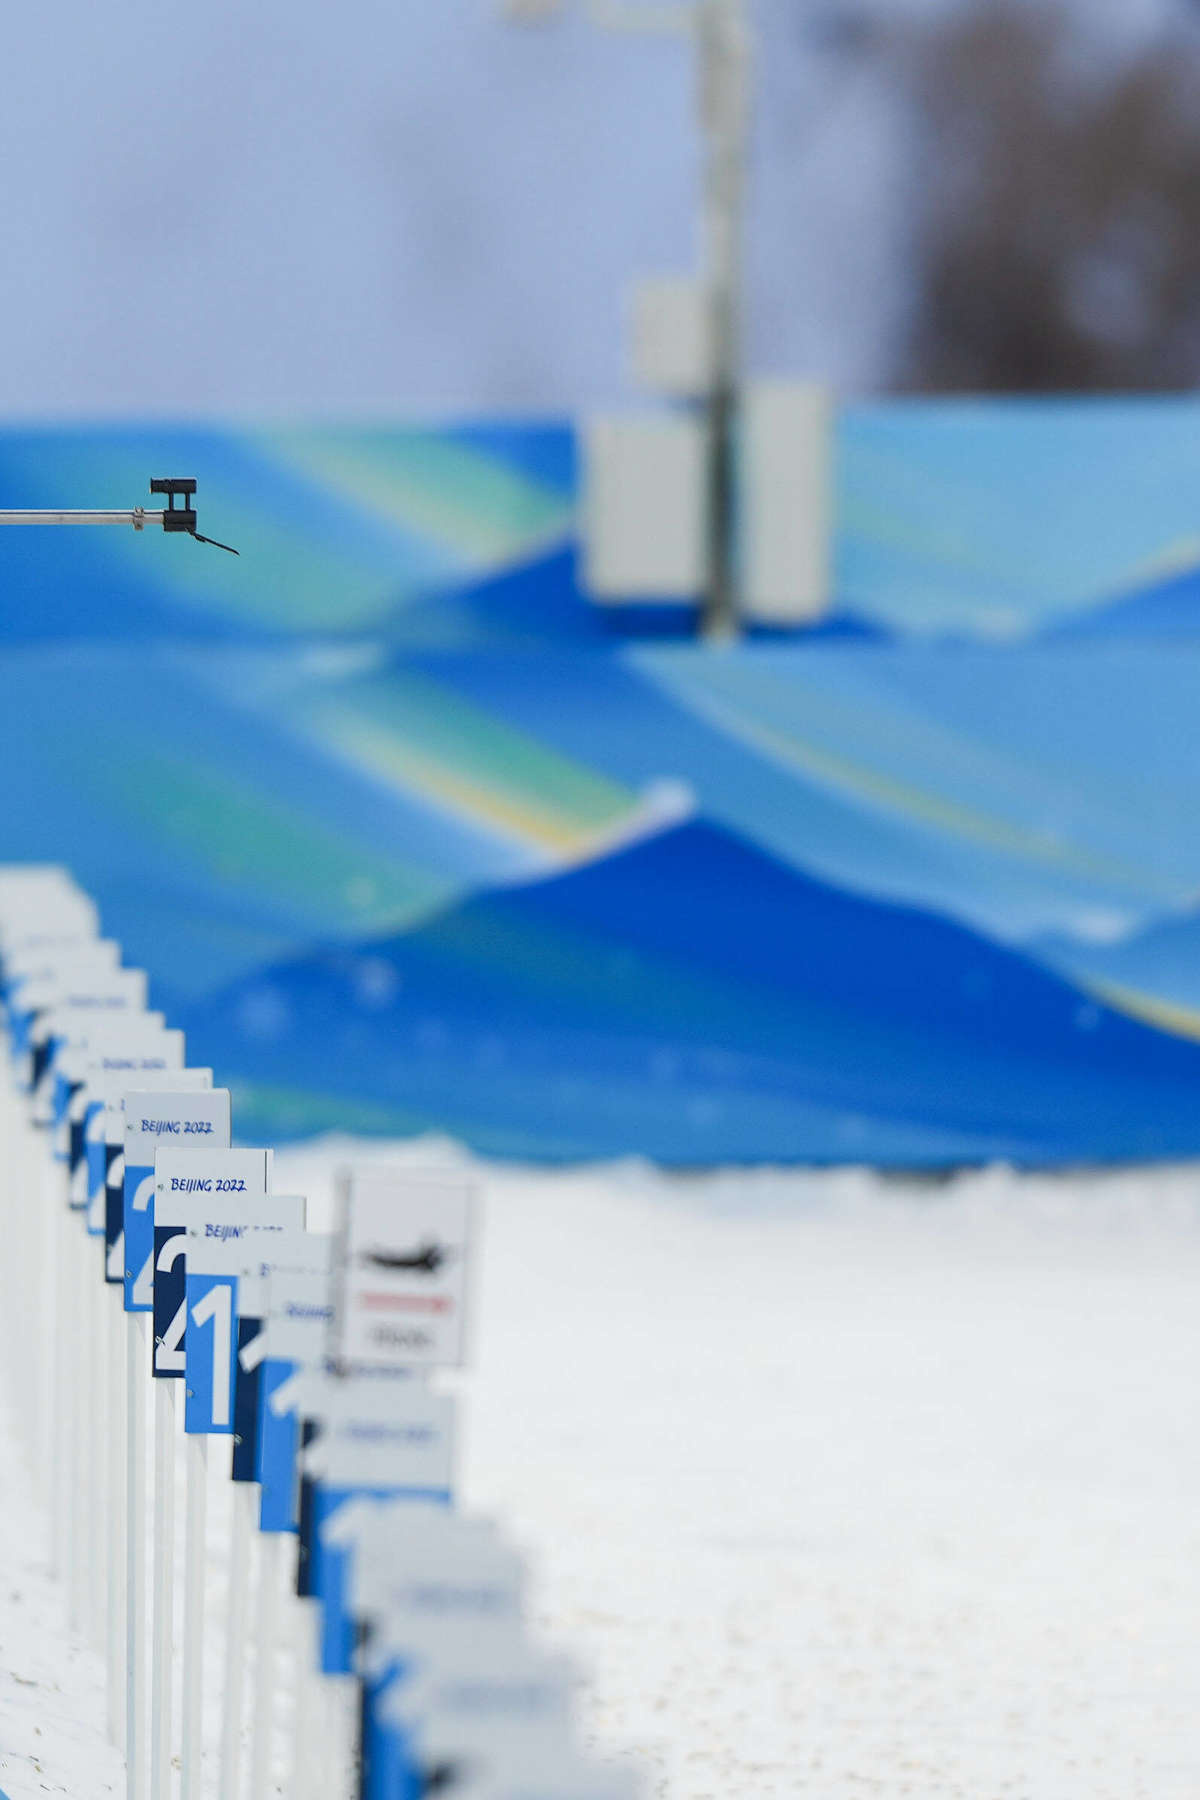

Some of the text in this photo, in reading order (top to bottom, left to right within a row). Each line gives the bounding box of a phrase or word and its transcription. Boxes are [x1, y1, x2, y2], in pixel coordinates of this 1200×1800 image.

[141, 1119, 215, 1136] BEIJING 2022
[171, 1178, 247, 1194] BEIJING 2022
